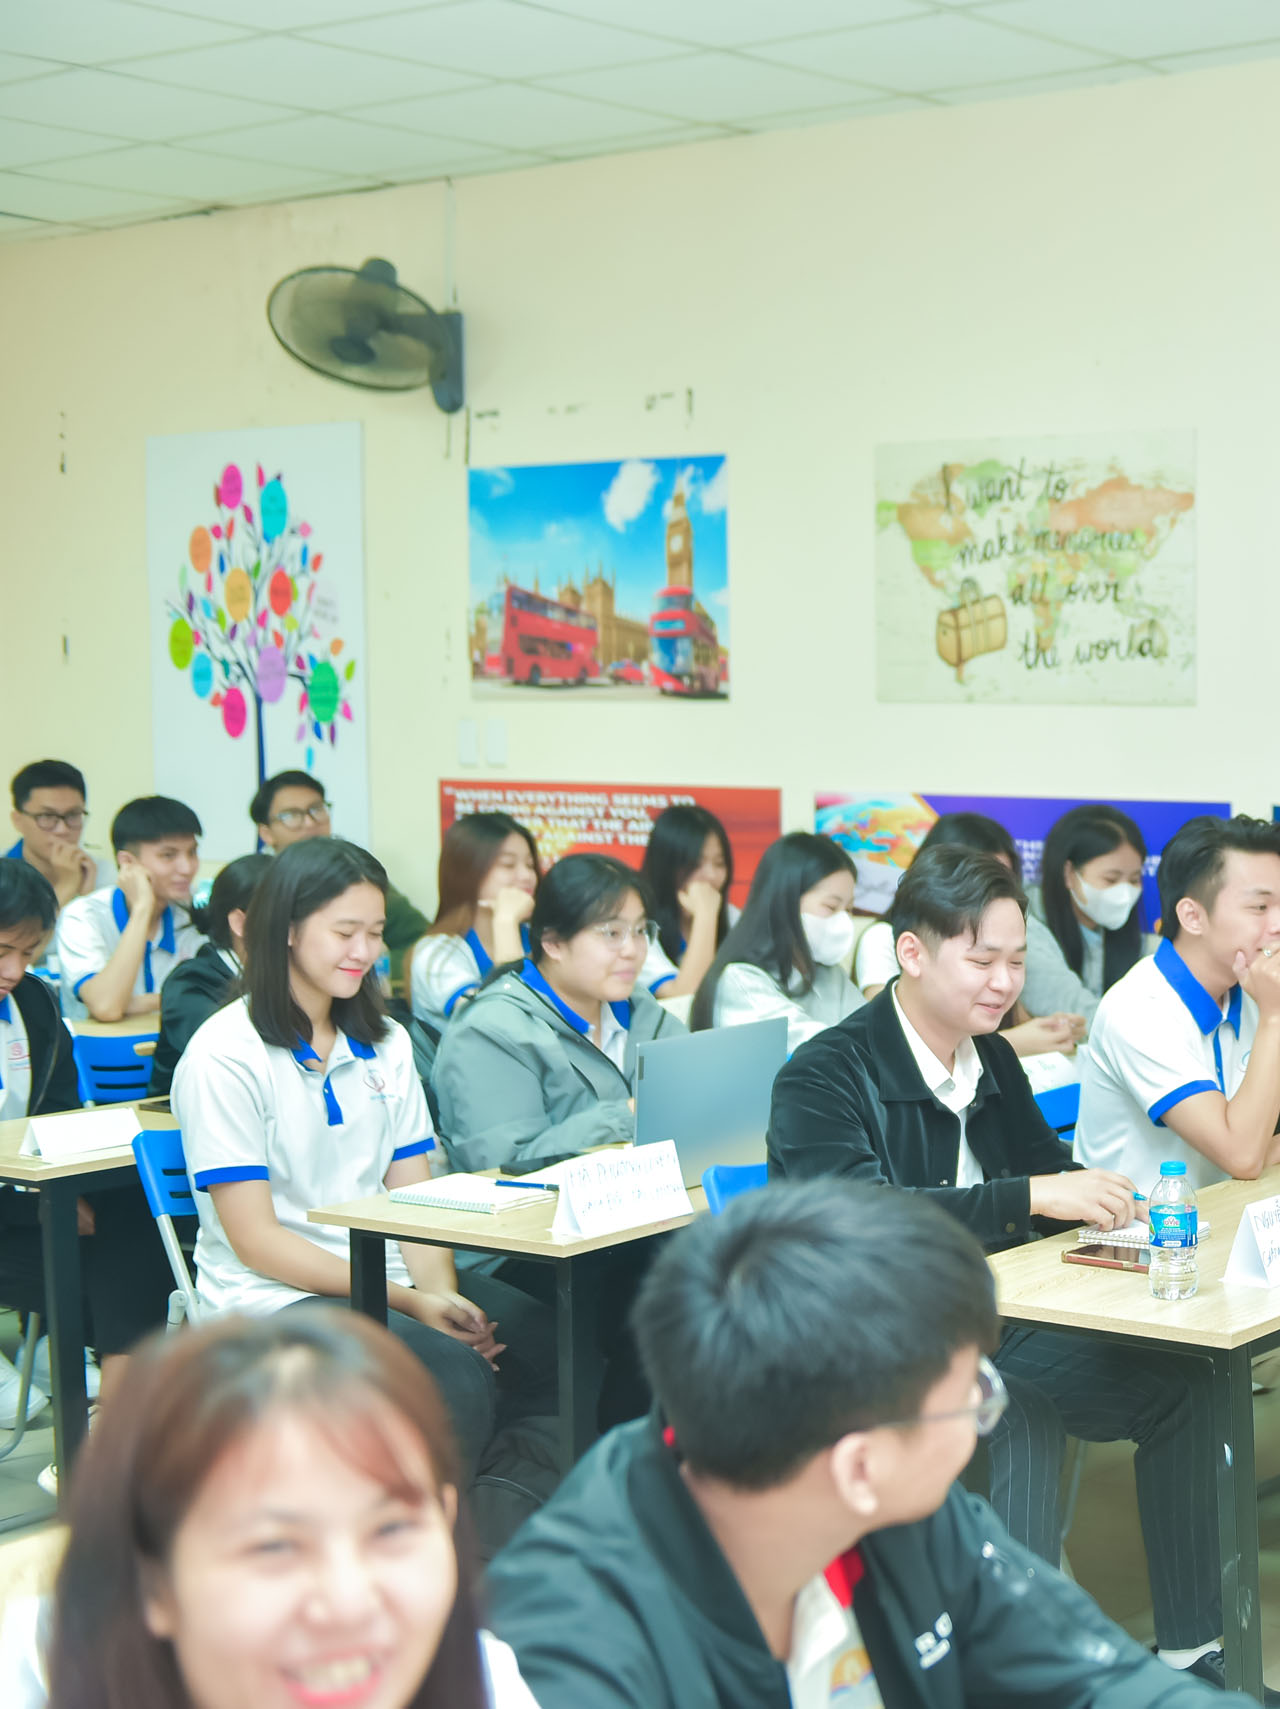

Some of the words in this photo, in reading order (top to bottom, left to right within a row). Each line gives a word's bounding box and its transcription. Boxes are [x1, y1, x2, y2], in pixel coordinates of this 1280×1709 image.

[966, 458, 1030, 510] want
[1042, 462, 1069, 502] to
[957, 519, 1026, 568] make
[1011, 572, 1050, 606] all
[1065, 579, 1121, 603] over
[1018, 629, 1060, 669] the
[1075, 618, 1168, 665] world
[454, 801, 476, 815] BE
[478, 802, 531, 817] GOING
[534, 804, 607, 819] AGAINST
[506, 790, 609, 807] EVERYTHING
[612, 793, 668, 808] SEEMS
[671, 795, 696, 807] TO
[549, 817, 590, 832] THAT
[593, 818, 625, 832] THE
[549, 830, 615, 845] AGAINST
